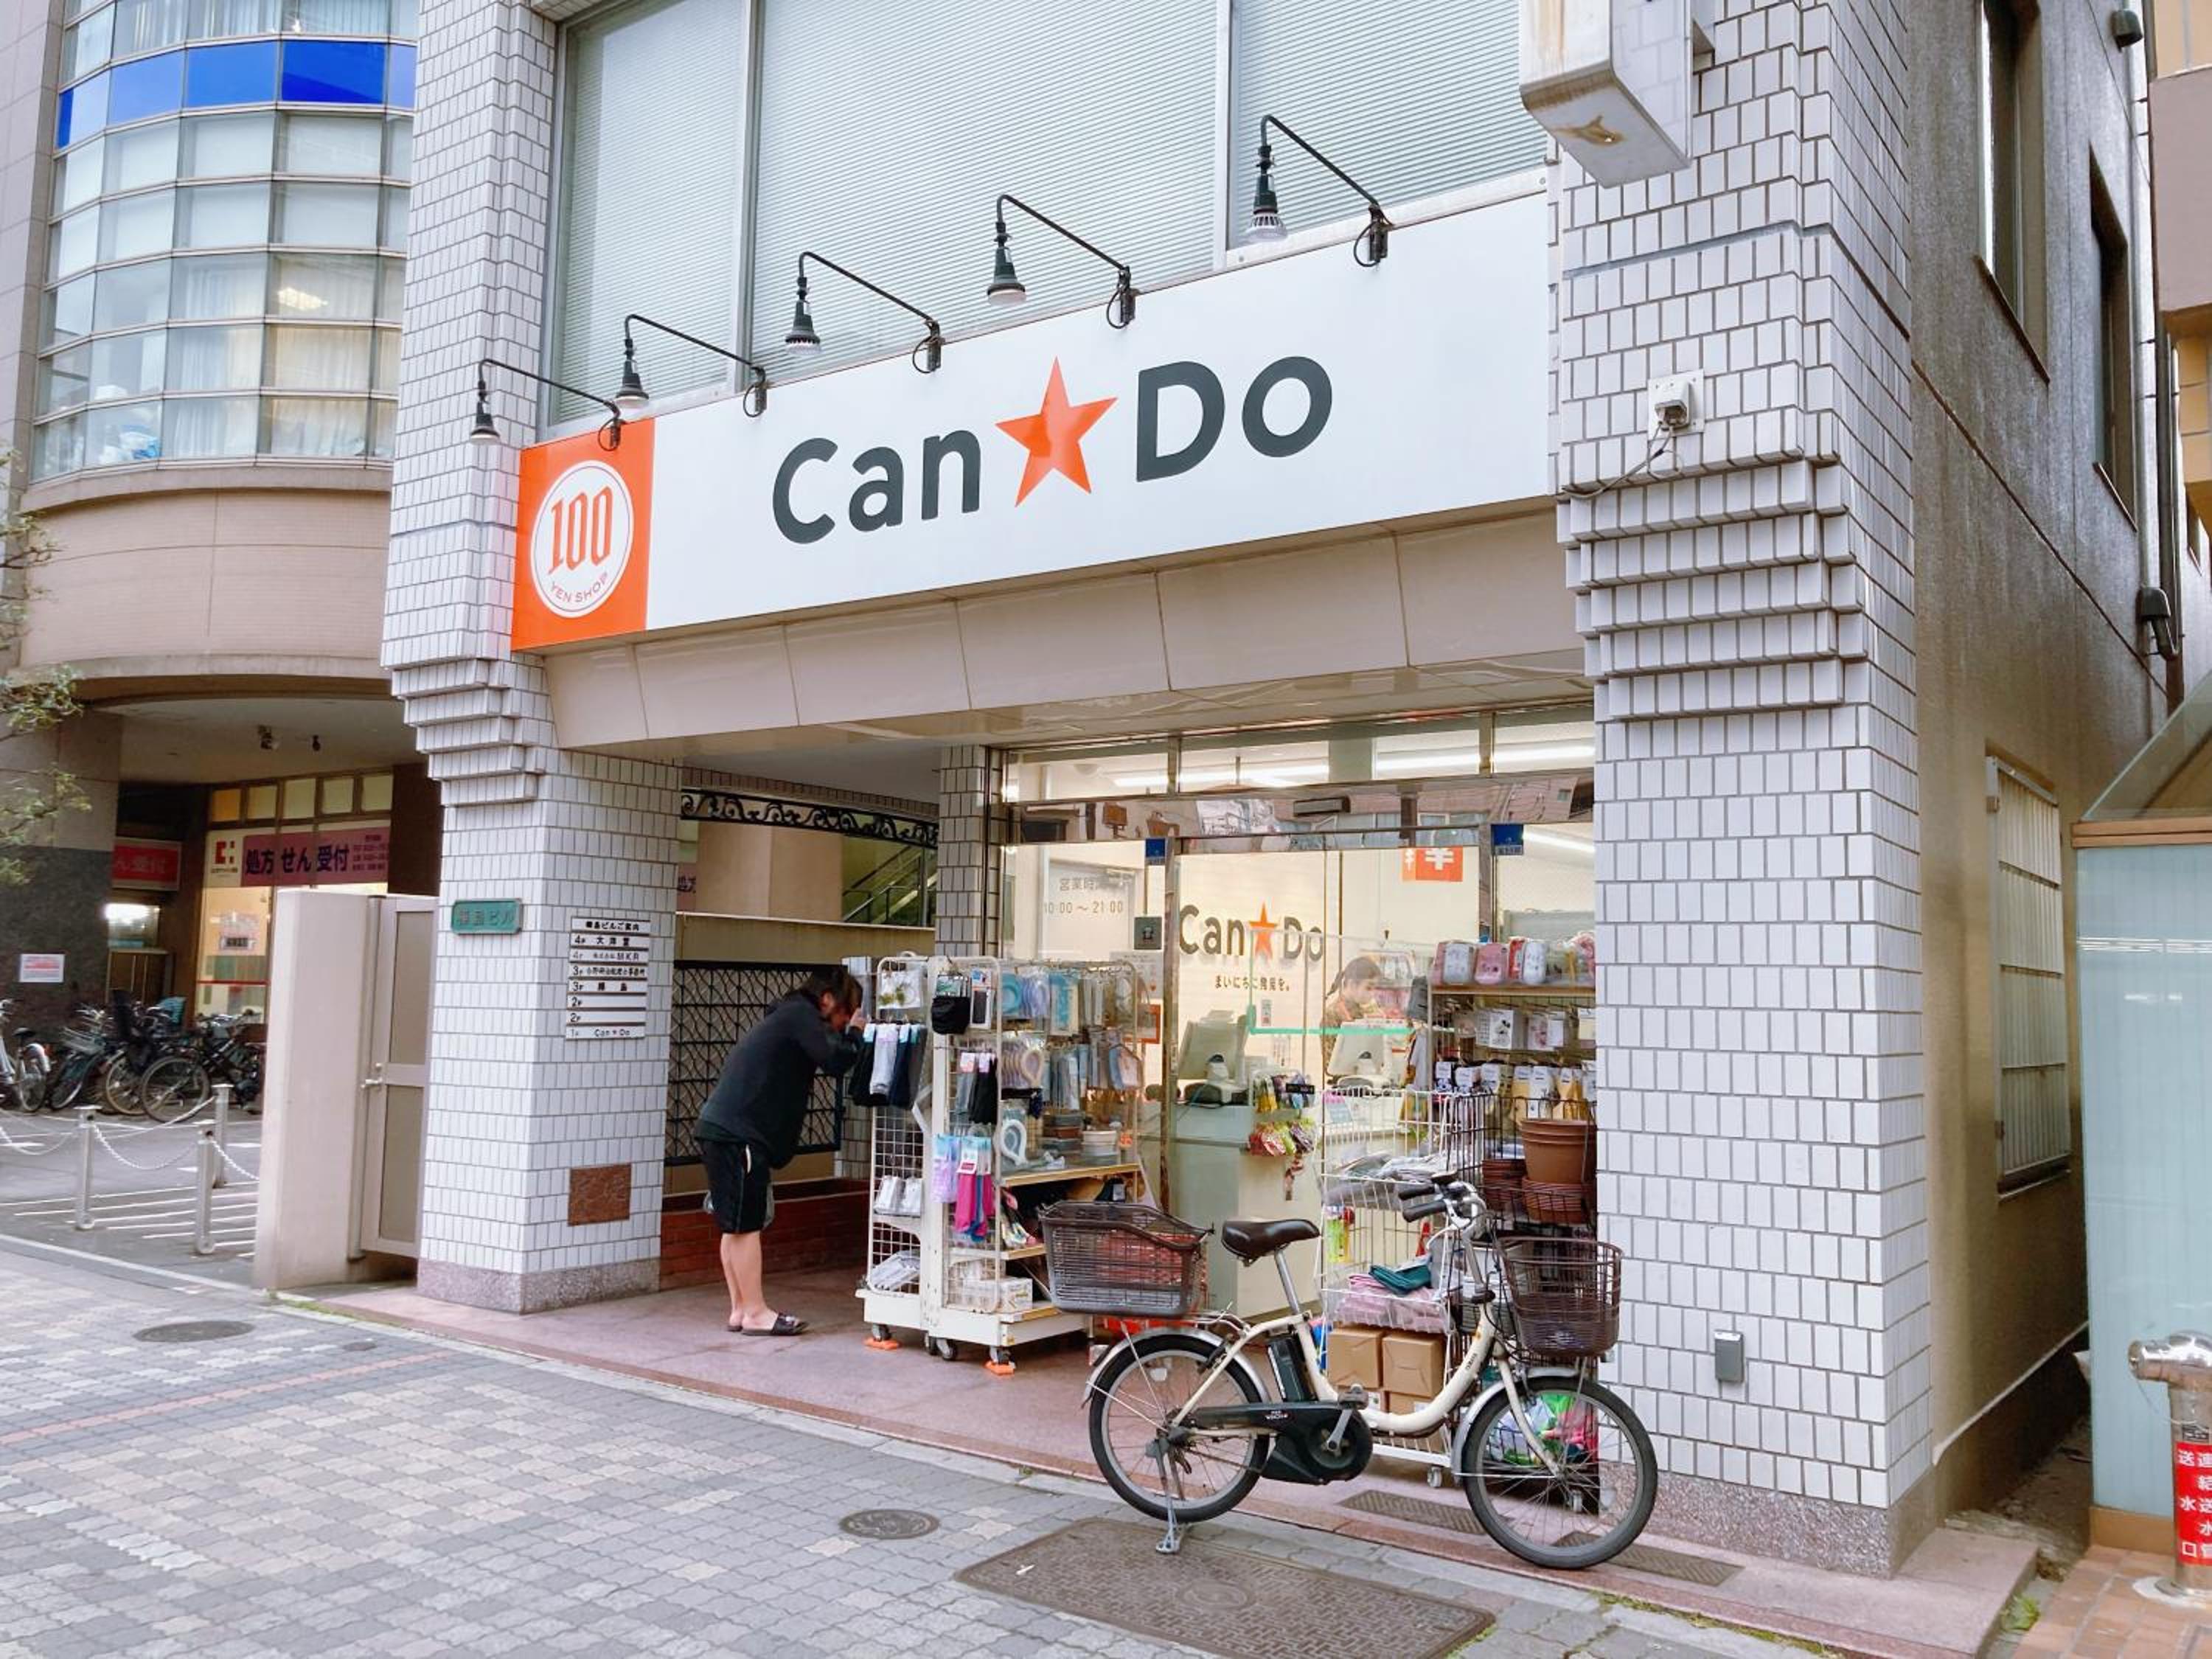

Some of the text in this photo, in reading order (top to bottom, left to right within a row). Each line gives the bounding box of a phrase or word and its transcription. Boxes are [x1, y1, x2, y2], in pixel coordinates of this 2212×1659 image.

[773, 356, 1332, 544] Can Do
[548, 486, 613, 575] 100
[551, 571, 608, 603] YEN SHOP
[1180, 905, 1323, 961] Can Do
[2178, 1450, 2197, 1557] 送水口
